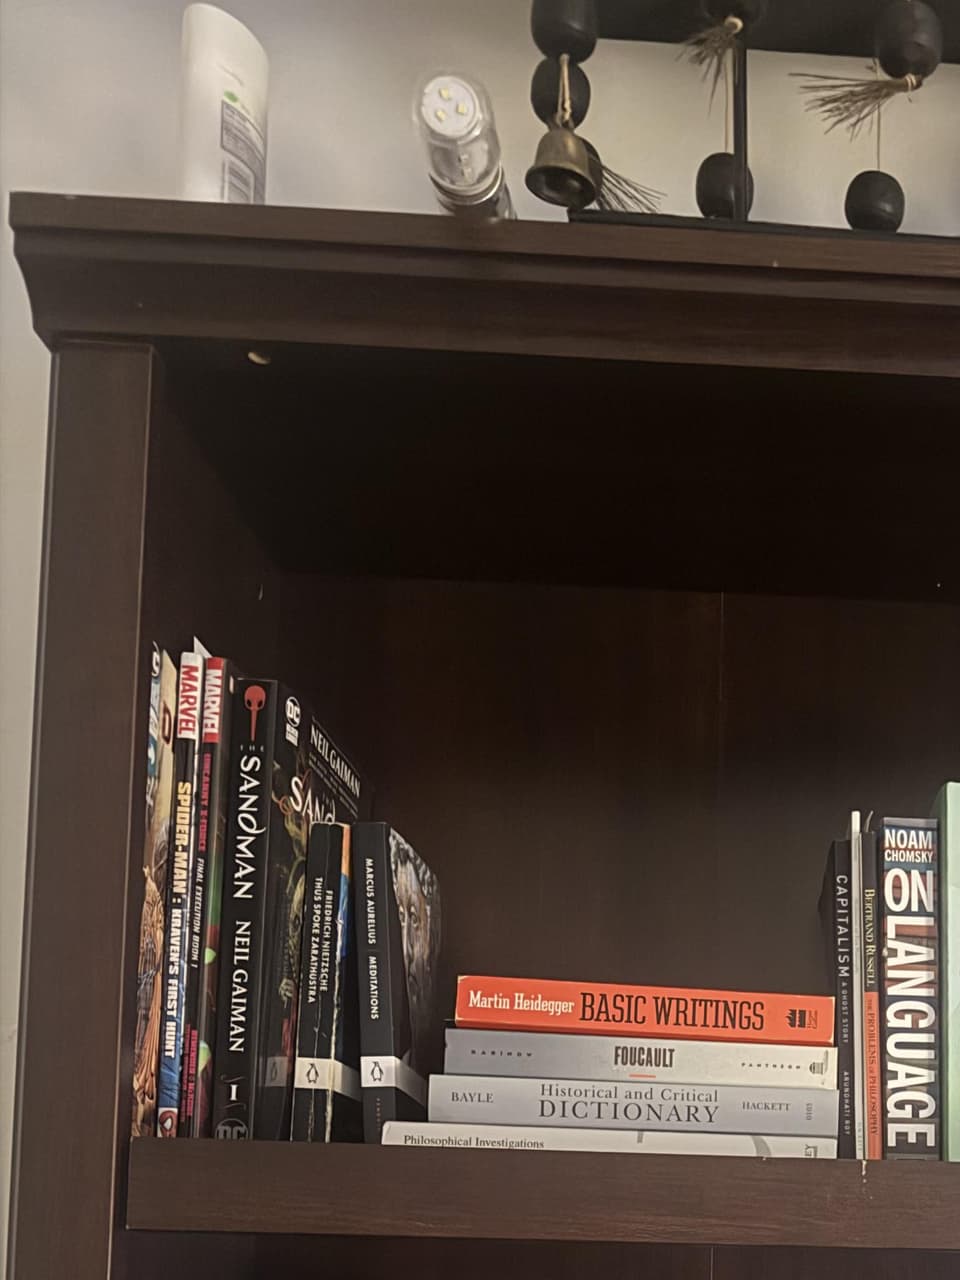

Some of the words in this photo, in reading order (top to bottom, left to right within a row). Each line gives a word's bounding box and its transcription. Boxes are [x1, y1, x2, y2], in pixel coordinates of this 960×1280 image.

[177, 665, 199, 734] MARVEL
[203, 668, 223, 735] MARVEL
[232, 755, 267, 899] SANDMAN
[884, 830, 933, 849] NOAM
[884, 851, 933, 864] CHOMSKY
[365, 858, 374, 897] MARCUS
[884, 868, 934, 913] ON
[234, 920, 252, 963] NEIL
[367, 901, 376, 944] AURELIUS
[370, 956, 379, 1019] MEDITATIONS
[468, 990, 511, 1010] Martin
[513, 993, 574, 1016] Heidegger
[229, 969, 249, 1053] GAIMAN
[579, 992, 647, 1024] BASIC
[652, 996, 764, 1031] WRITINGS
[886, 916, 937, 1147] LANGUAGE
[614, 1045, 675, 1069] FOUCAULT
[450, 1091, 494, 1104] BAYLE
[538, 1099, 719, 1124] DICTIONARY
[742, 1101, 791, 1112] HACKETT
[403, 1135, 472, 1149] Philosophical
[474, 1136, 544, 1149] Investigations
